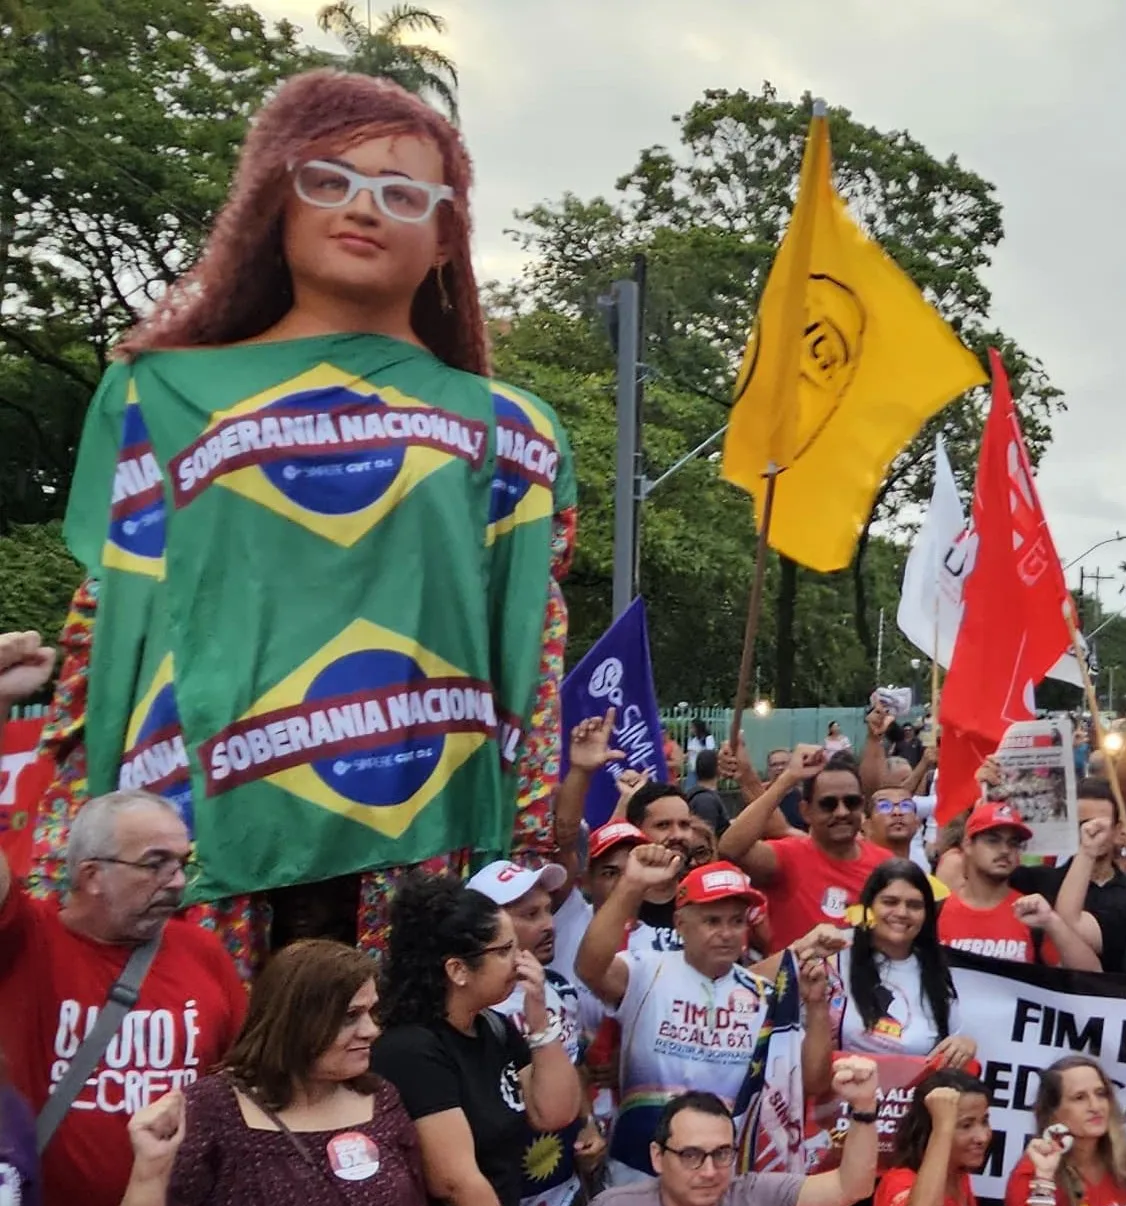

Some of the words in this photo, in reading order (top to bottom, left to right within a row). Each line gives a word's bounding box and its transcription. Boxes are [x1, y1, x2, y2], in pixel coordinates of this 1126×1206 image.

[178, 413, 340, 491] SOBERANIA
[210, 699, 389, 781] SOBERANIA
[658, 1020, 722, 1048] ESCALA
[726, 1033, 754, 1049] 6X1
[1011, 997, 1105, 1057] FIM
